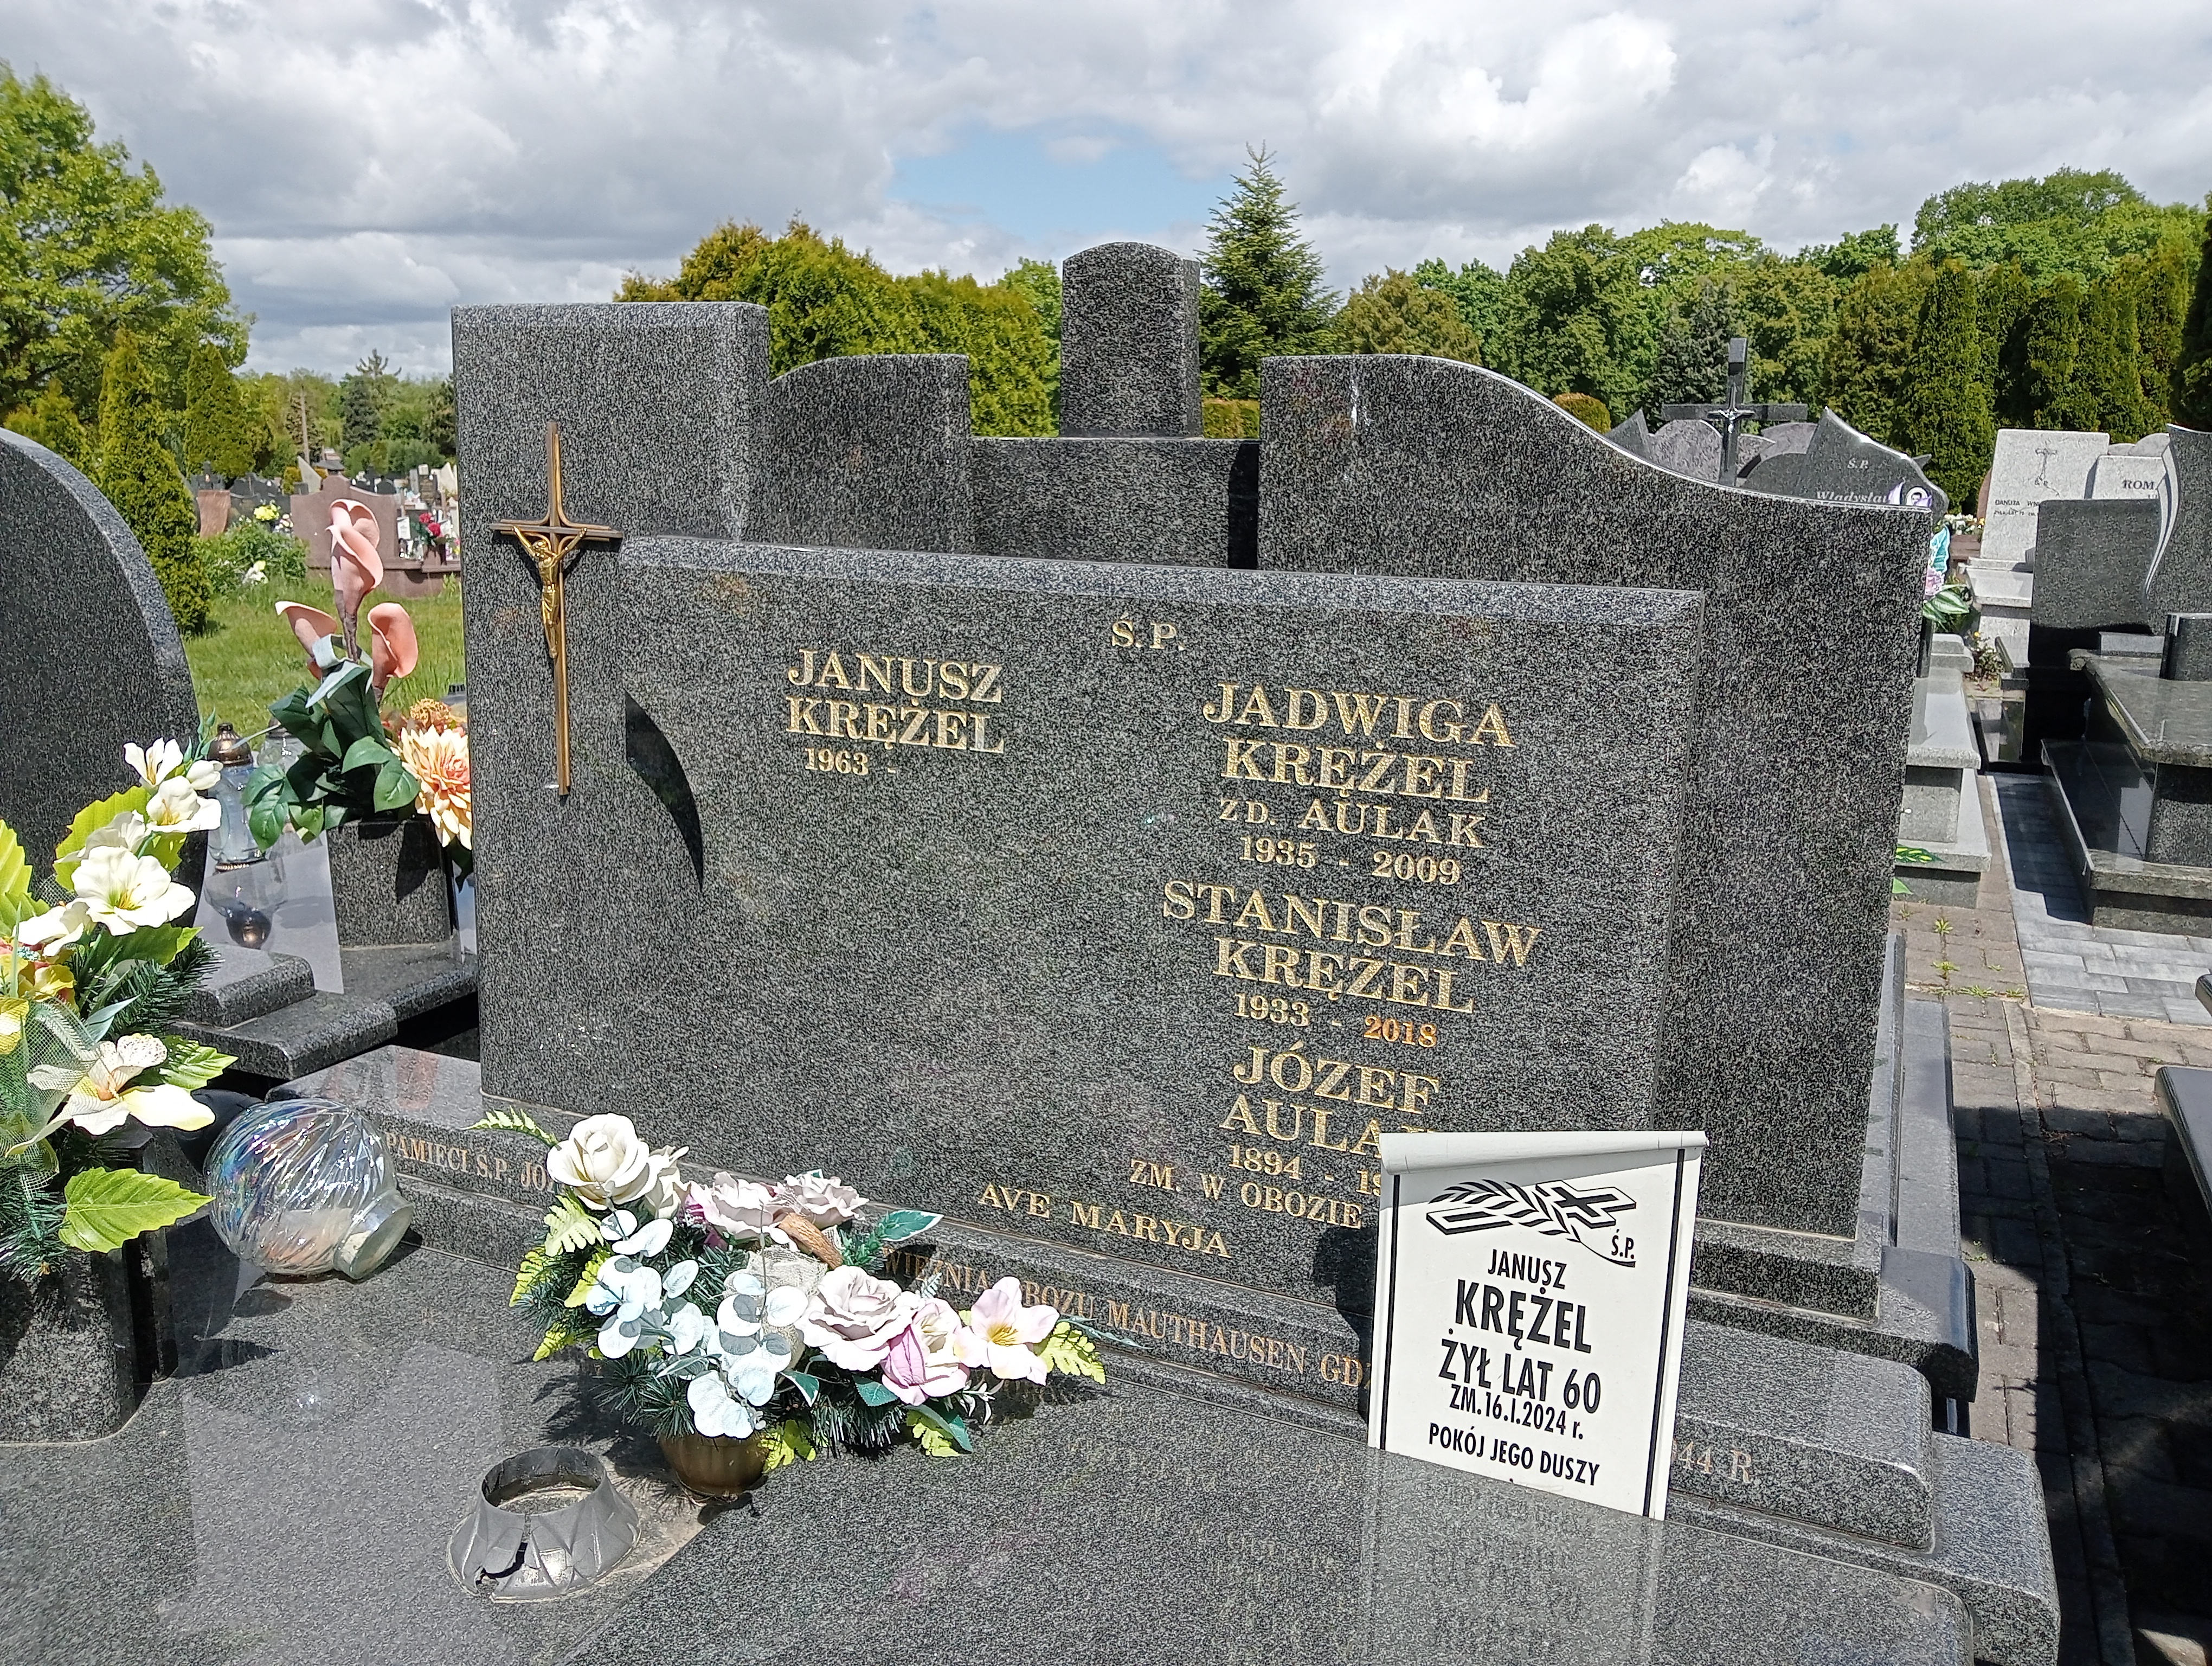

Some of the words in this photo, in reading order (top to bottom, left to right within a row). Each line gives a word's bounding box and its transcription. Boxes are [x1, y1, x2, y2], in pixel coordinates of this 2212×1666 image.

[789, 648, 1002, 703] JANUSZ
[786, 696, 1004, 753] KRĘŻEL
[1203, 682, 1516, 747] JADWIGA
[805, 748, 869, 776] 1963
[1220, 738, 1489, 803] KRĘŻEL
[1220, 799, 1277, 826] ZD.
[1300, 798, 1487, 848] AULAK
[1240, 836, 1316, 868] 1935
[1371, 851, 1460, 885] 2009
[1163, 879, 1544, 967] STANISŁAW
[1212, 937, 1475, 1014] KRĘŻEL
[1233, 993, 1309, 1027] 1933
[1364, 1015, 1437, 1048] 2018
[1233, 1040, 1439, 1114] JÓZEF
[1219, 1093, 1435, 1158] AULA
[1130, 1158, 1182, 1192] ZM.
[1199, 1173, 1226, 1200] W
[1240, 1182, 1363, 1228] OBOZIE
[1229, 1143, 1302, 1180] 1894
[978, 1183, 1051, 1222] AVE
[1070, 1199, 1233, 1259] MARYJA
[1488, 1249, 1567, 1290] JANUSZ
[1020, 1280, 1096, 1319] BOZU
[1106, 1299, 1308, 1374] MAUTHAUSEN
[1455, 1279, 1592, 1354] KRĘŻEL
[1439, 1329, 1491, 1389] ŻYŁ
[1502, 1353, 1553, 1402] LAT
[1562, 1369, 1601, 1413] 60
[1429, 1423, 1485, 1457] POKÓJ
[1490, 1441, 1533, 1470] JEGO
[1540, 1452, 1600, 1486] DUSZY
[1573, 1421, 1584, 1439] r.
